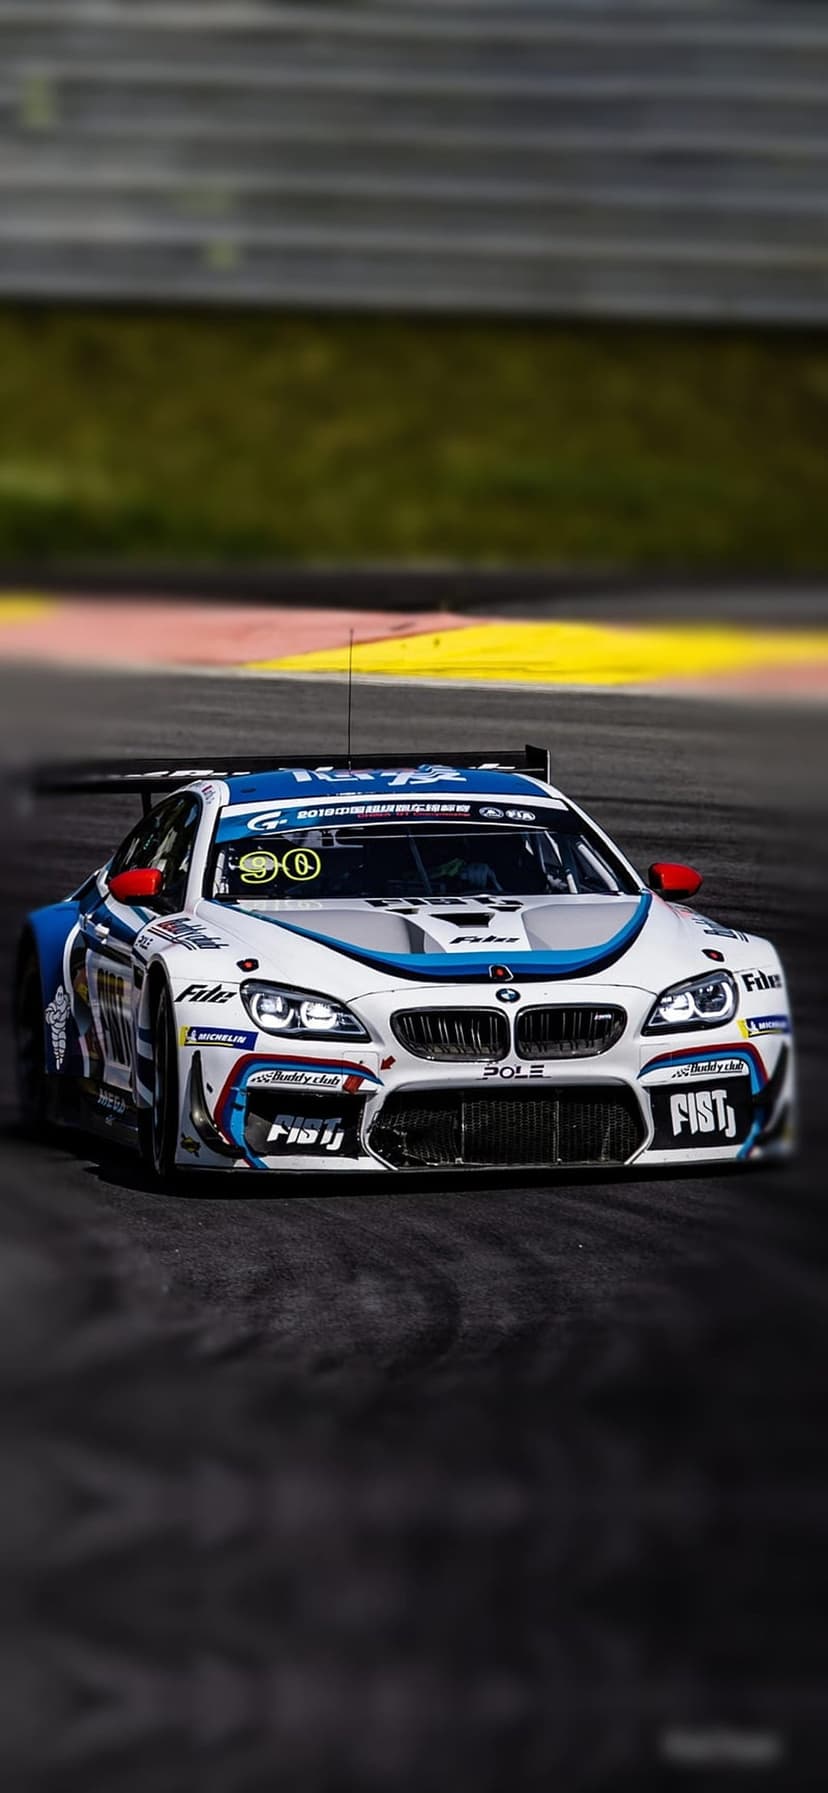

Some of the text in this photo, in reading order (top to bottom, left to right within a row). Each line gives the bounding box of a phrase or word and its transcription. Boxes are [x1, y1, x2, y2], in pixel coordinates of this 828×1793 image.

[240, 848, 321, 884] 90
[198, 1032, 247, 1044] MICHELIN
[483, 1065, 544, 1079] POLE
